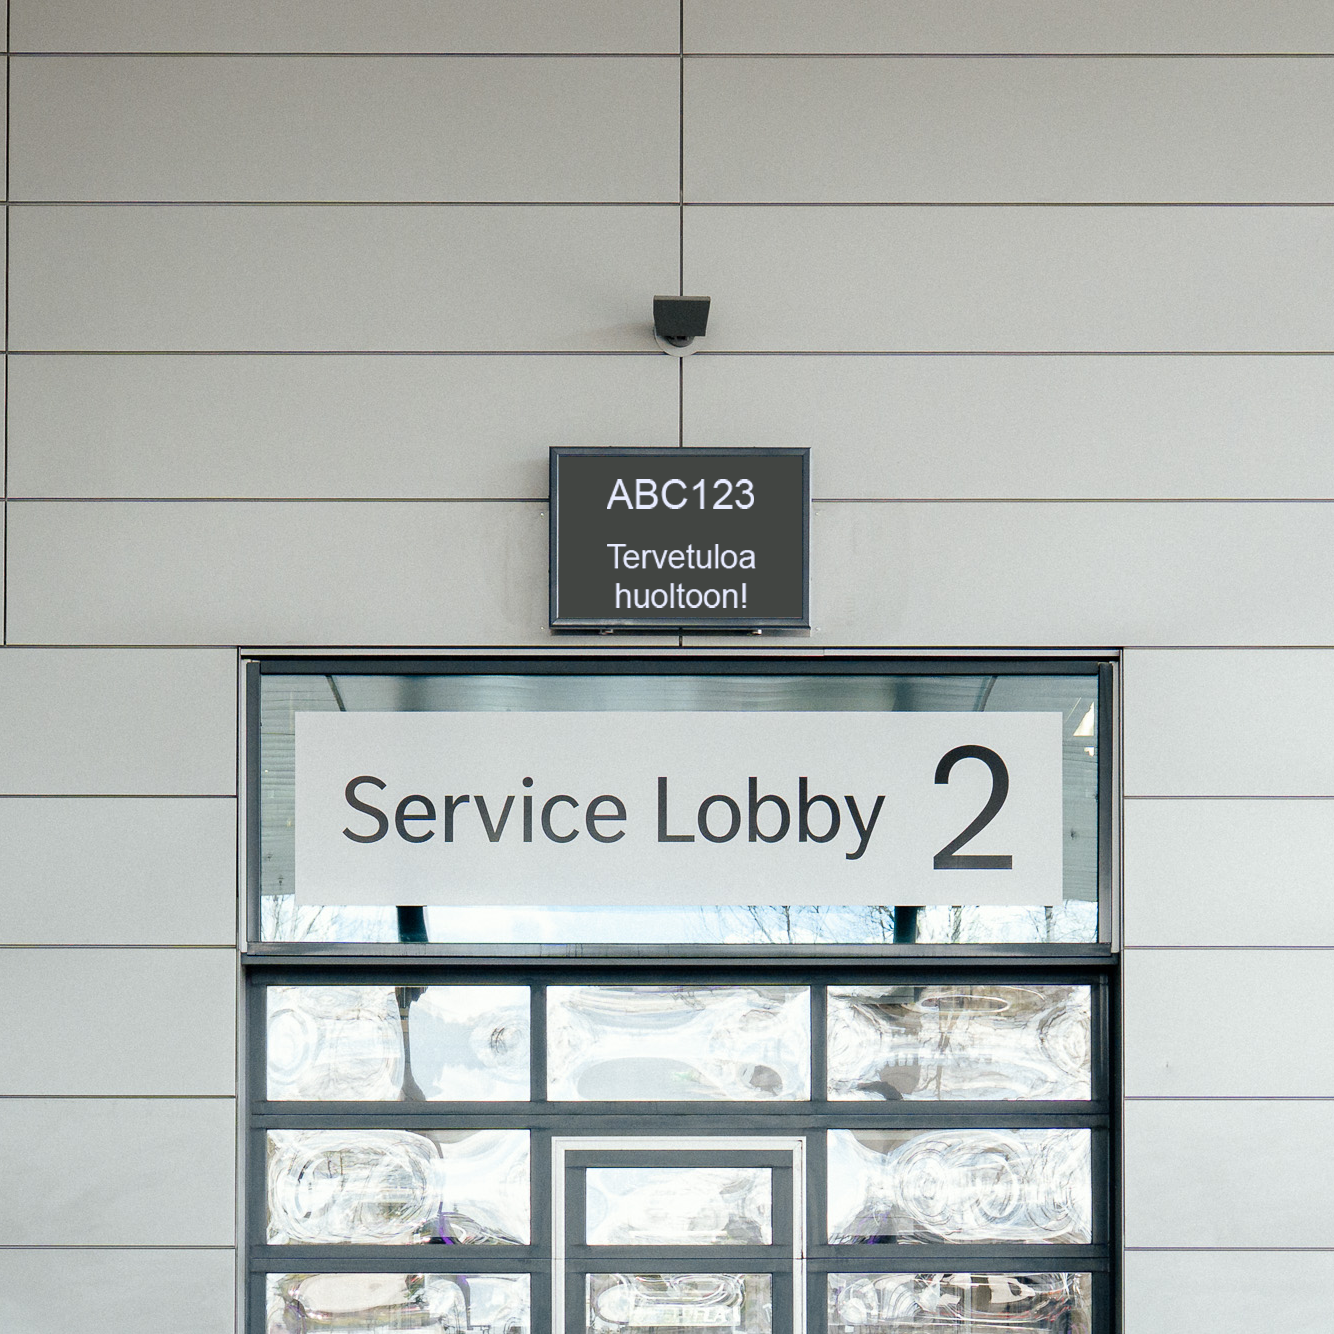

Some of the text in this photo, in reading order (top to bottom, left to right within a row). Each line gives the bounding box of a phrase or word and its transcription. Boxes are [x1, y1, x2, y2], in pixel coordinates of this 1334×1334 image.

[606, 478, 756, 510] ABC123
[606, 543, 757, 569] Tervetuloa
[614, 582, 748, 609] huoltoon!
[342, 744, 1013, 870] Service Lobby 2
